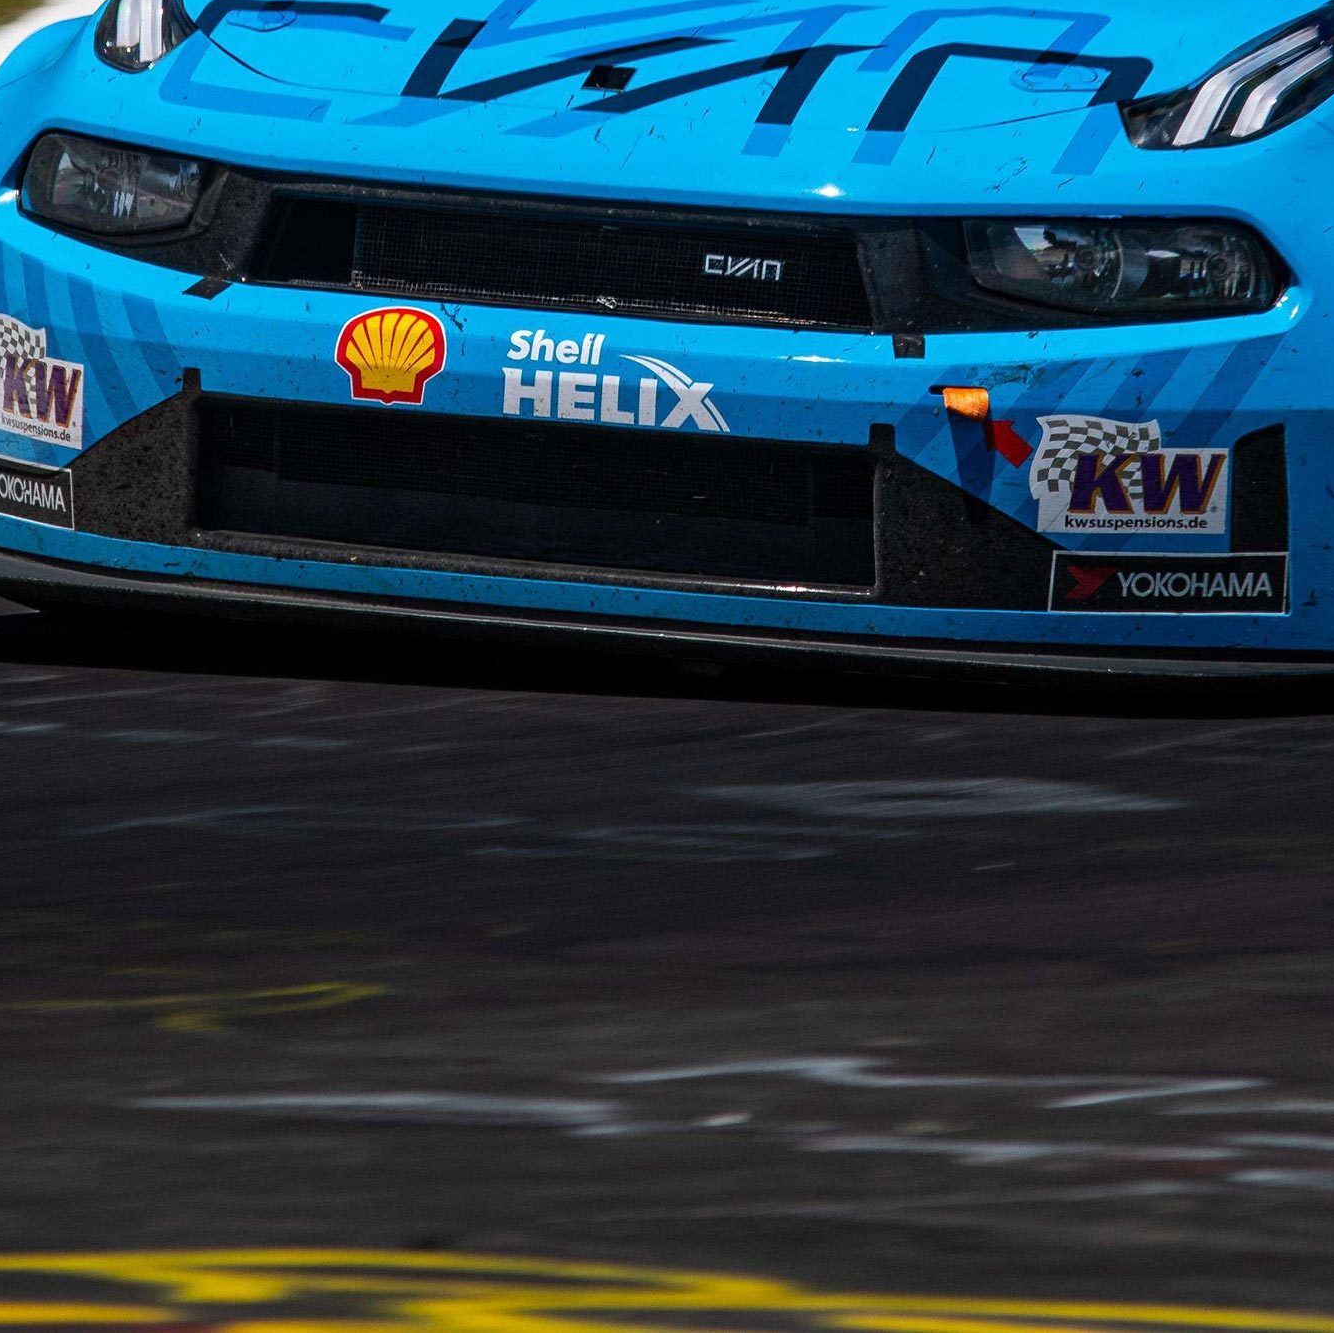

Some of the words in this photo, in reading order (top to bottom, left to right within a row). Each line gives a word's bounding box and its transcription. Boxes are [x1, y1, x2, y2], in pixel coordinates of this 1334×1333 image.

[506, 328, 606, 366] Shell
[2, 351, 82, 429] KW
[501, 356, 731, 433] HELIX
[1, 413, 72, 443] kwsuspensions.de
[1067, 452, 1228, 516] KW
[1063, 515, 1209, 531] kwsuspensions.de
[1117, 571, 1274, 598] YOKOHAMA
